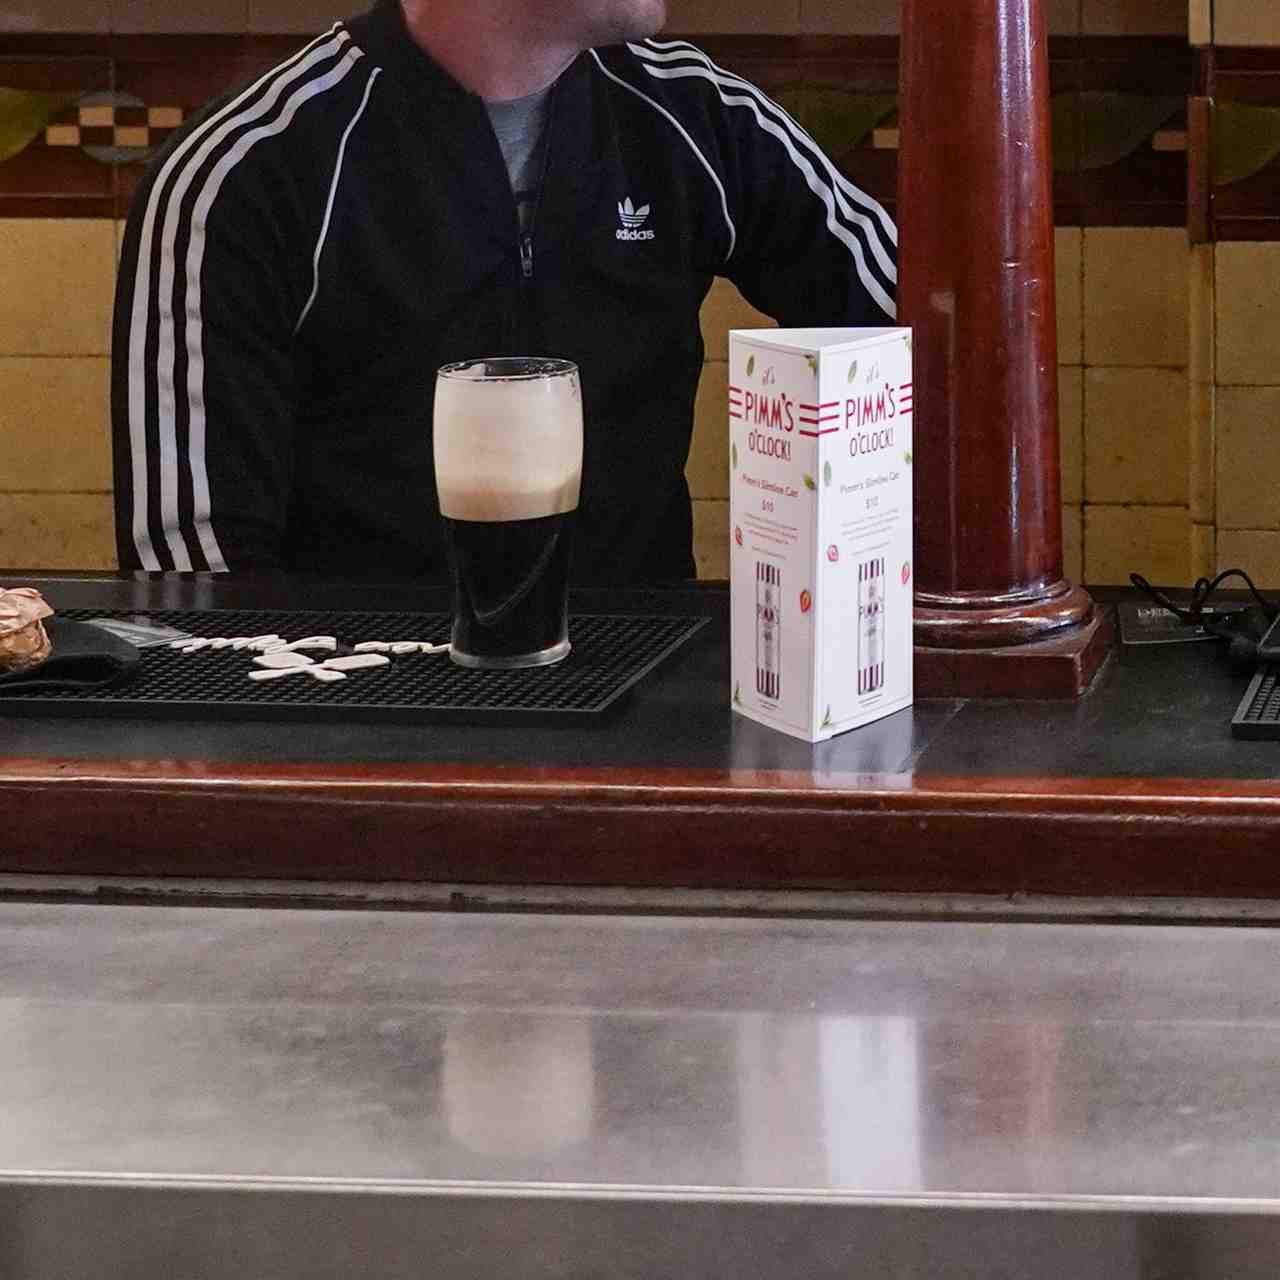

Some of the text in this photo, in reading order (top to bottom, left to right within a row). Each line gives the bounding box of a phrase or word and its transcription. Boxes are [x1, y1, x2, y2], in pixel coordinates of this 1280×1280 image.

[615, 228, 655, 241] adidas
[744, 391, 795, 433] PIMM'S
[845, 382, 896, 430] PIMM'S
[747, 429, 792, 462] O'CLOCK!
[849, 427, 895, 458] O'CLOCK!
